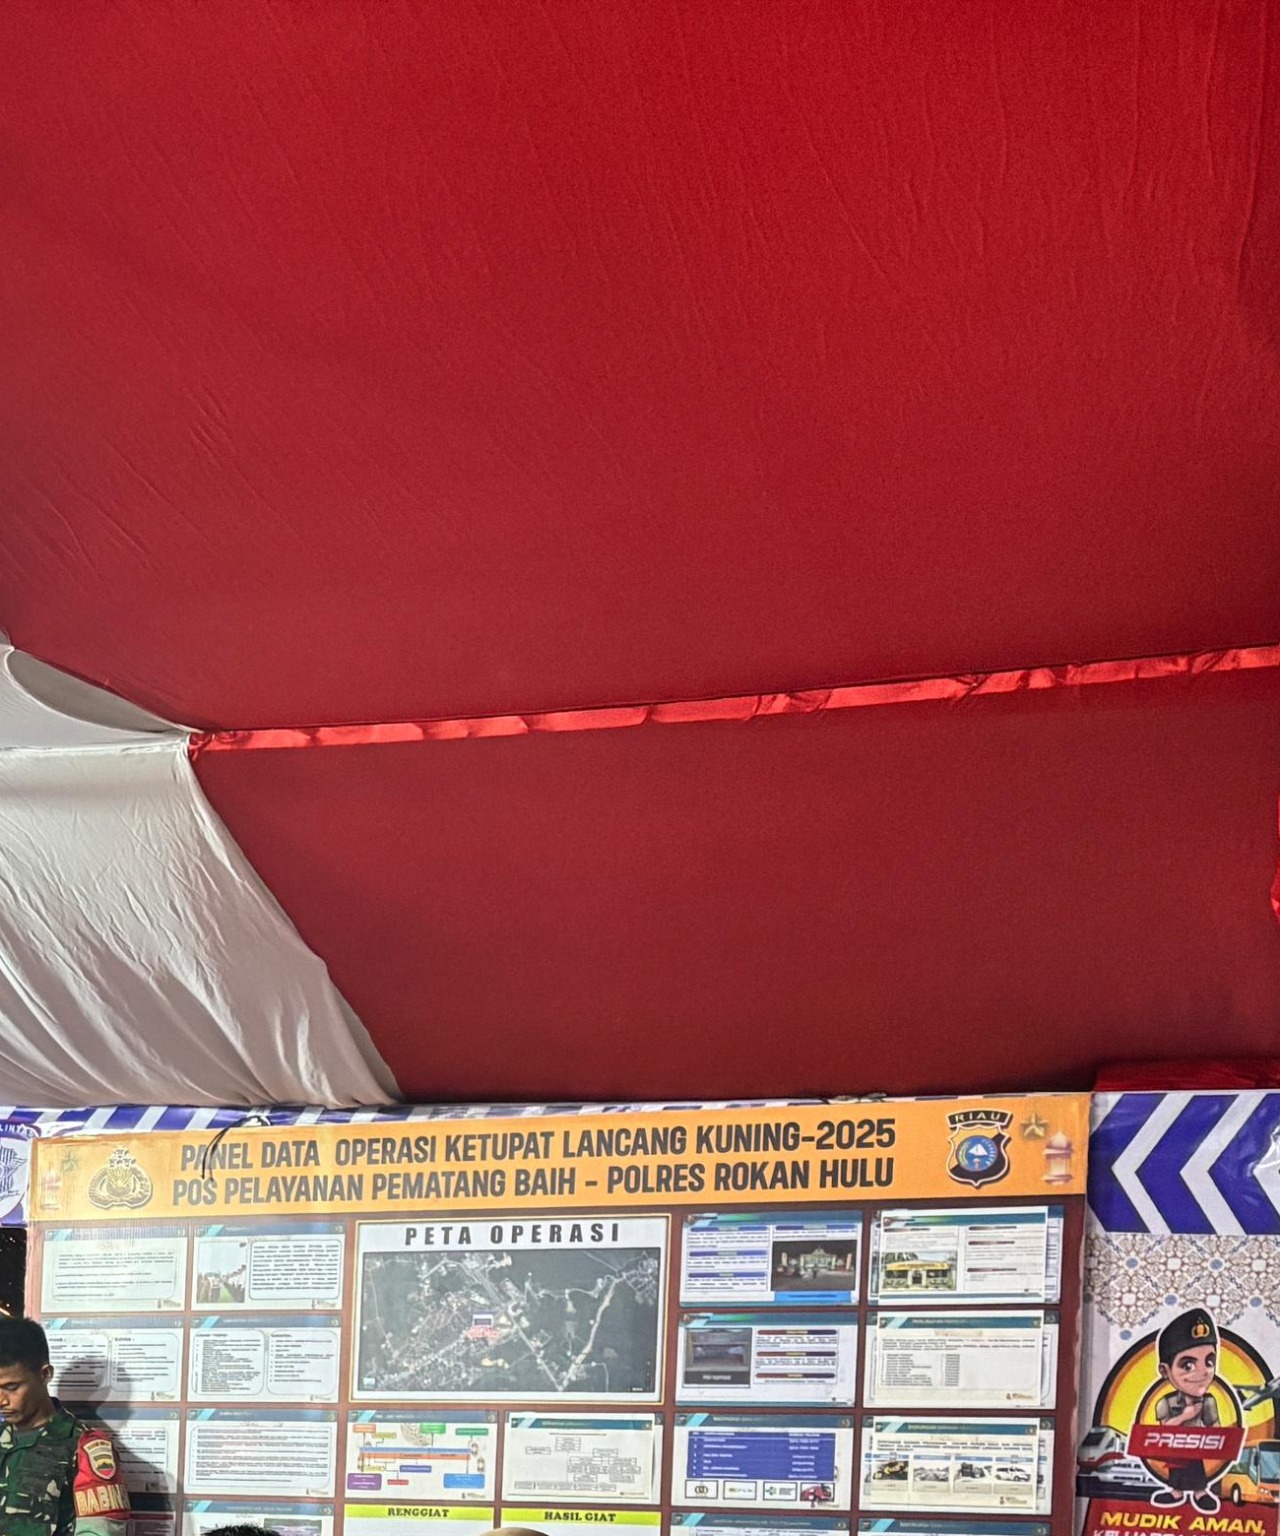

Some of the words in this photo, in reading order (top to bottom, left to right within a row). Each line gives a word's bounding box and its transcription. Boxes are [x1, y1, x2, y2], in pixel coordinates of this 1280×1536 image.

[955, 1112, 1000, 1122] RIAU
[181, 1142, 253, 1171] PANEL
[261, 1140, 320, 1168] DATA
[336, 1137, 435, 1166] OPERASI
[446, 1130, 555, 1163] KETUPAT
[563, 1123, 686, 1160] LANCANG
[696, 1117, 896, 1154] KUNING-2025
[173, 1177, 217, 1206] POS
[225, 1173, 361, 1205] PELAYANAN
[372, 1169, 506, 1200] PEMATANG
[514, 1166, 576, 1197] BAIH
[607, 1163, 705, 1193] POLRES
[714, 1160, 810, 1191] ROKAN
[820, 1157, 895, 1188] HULU
[405, 1225, 473, 1246] PETA
[490, 1221, 621, 1245] OPERASI
[1144, 1433, 1226, 1450] PRESISI
[388, 1508, 450, 1518] RENGGIAT
[544, 1511, 582, 1522] HASIL
[585, 1513, 616, 1522] GIAT
[1100, 1512, 1181, 1530] MUDIK
[1189, 1516, 1266, 1536] AMAN,
